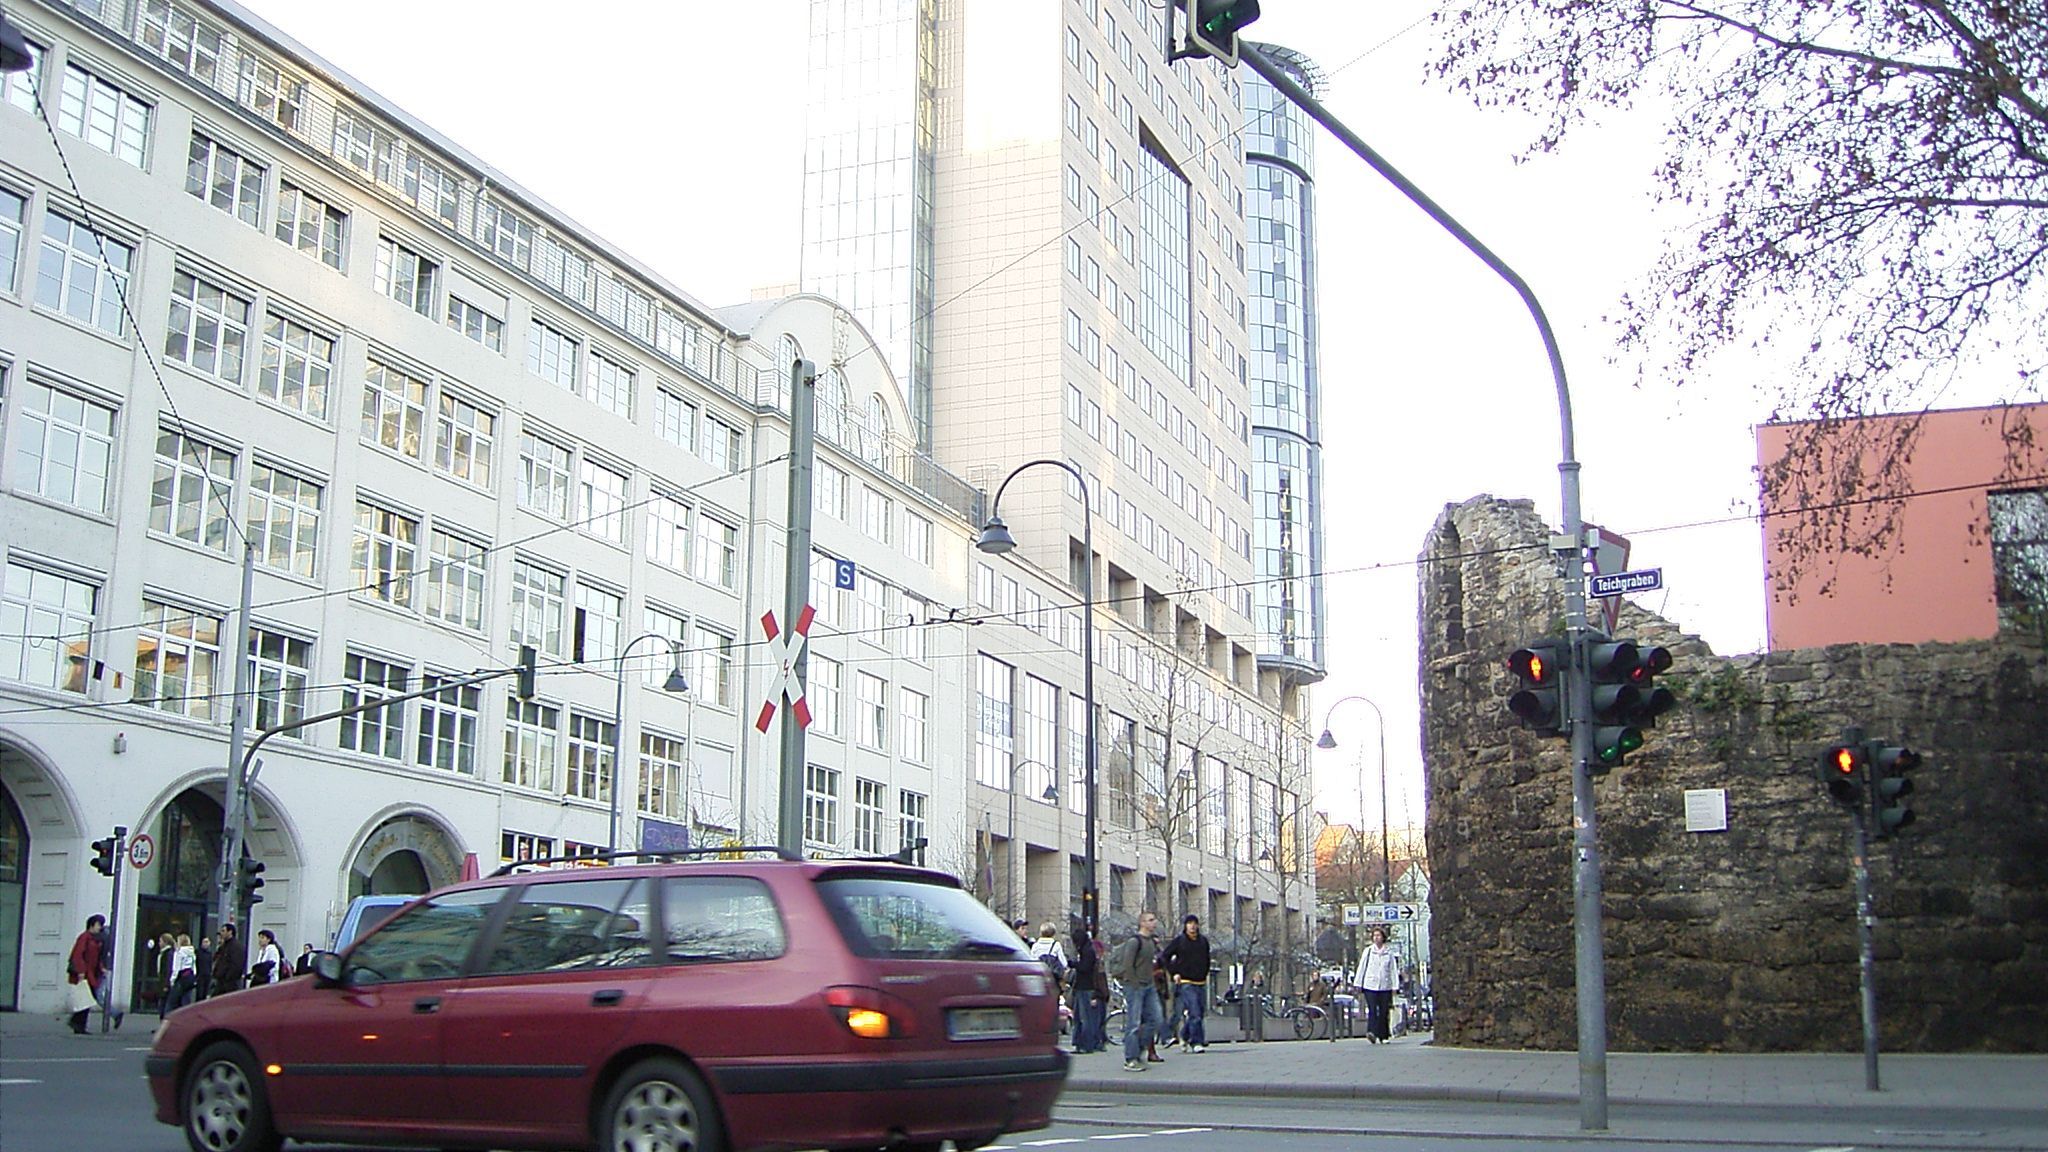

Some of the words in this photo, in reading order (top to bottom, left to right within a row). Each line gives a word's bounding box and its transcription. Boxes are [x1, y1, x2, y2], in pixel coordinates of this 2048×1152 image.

[840, 564, 851, 585] S
[1597, 574, 1655, 592] Teichgraben
[1388, 910, 1396, 920] P
